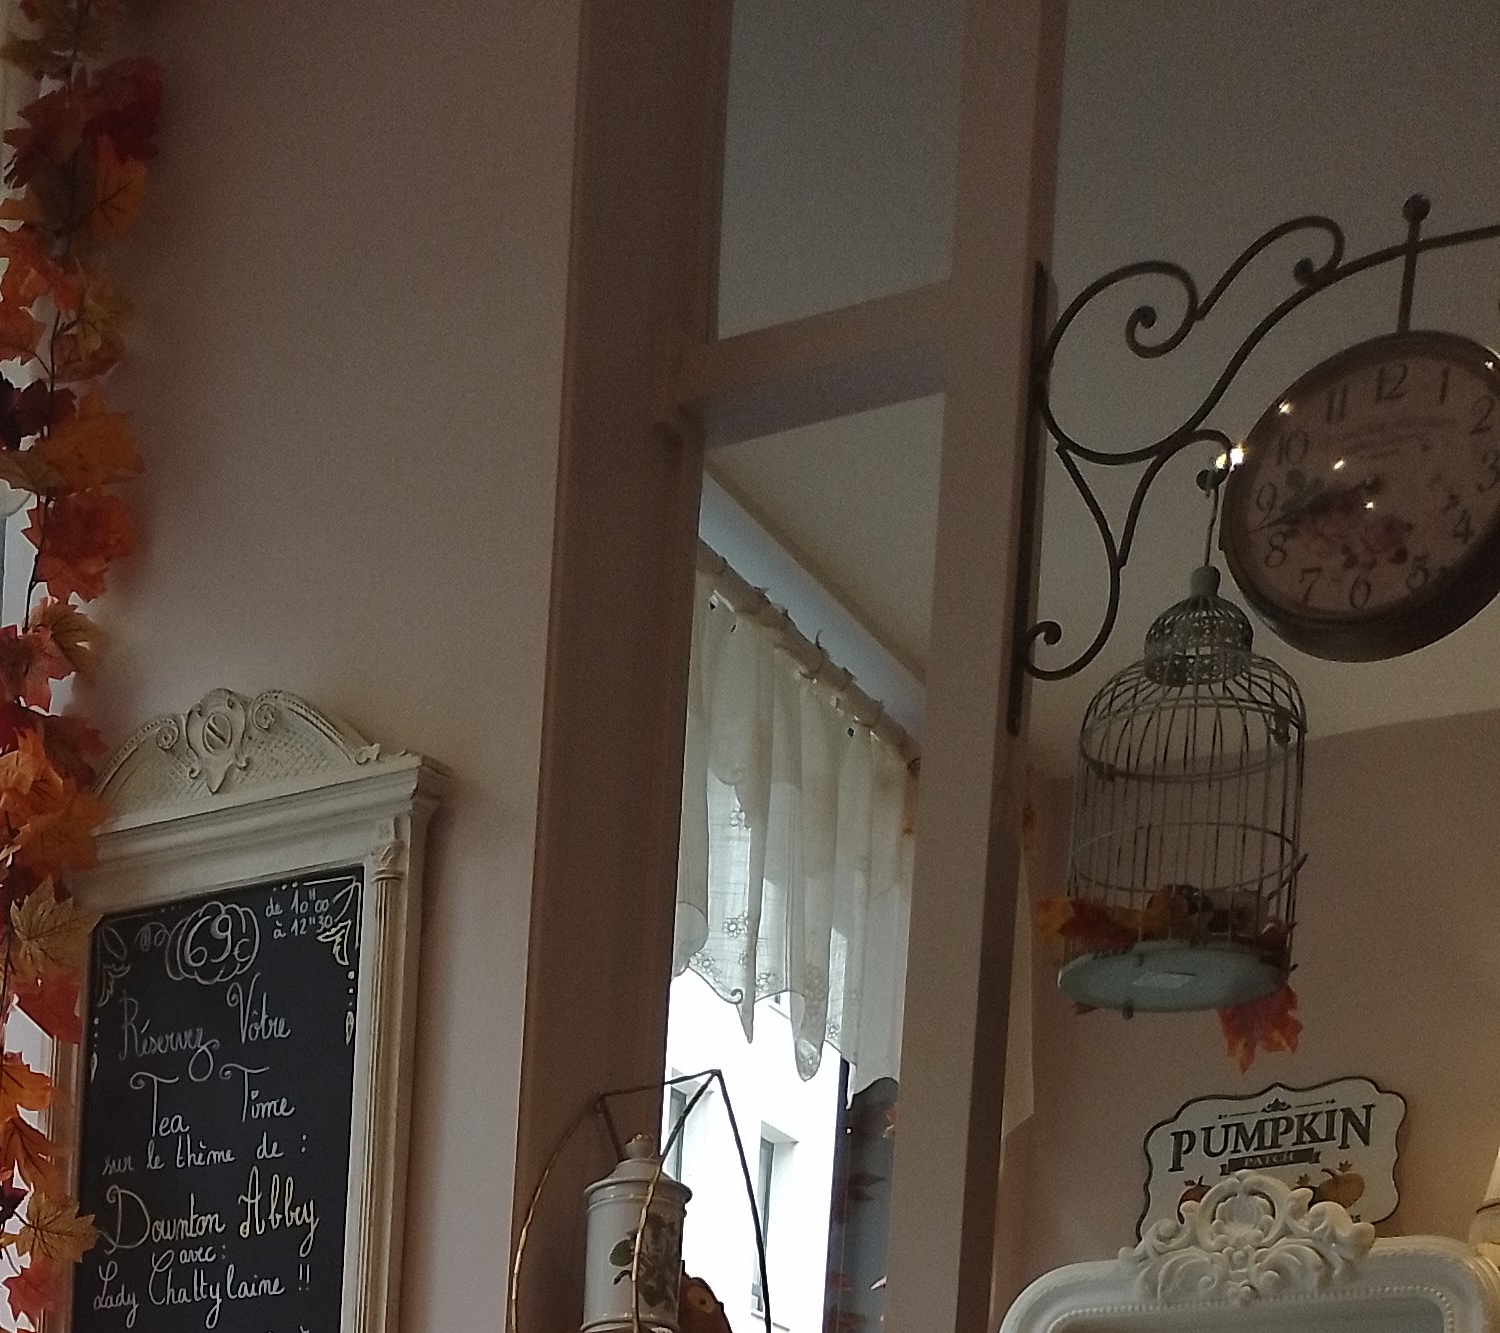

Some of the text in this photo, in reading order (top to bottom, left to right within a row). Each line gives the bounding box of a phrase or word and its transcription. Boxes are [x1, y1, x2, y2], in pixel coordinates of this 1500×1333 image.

[1376, 364, 1408, 403] 12
[1439, 369, 1449, 405] 1
[1326, 385, 1348, 422] 11
[1470, 396, 1496, 435] 2
[1276, 431, 1308, 467] 10
[1477, 452, 1500, 493] 3
[1253, 482, 1278, 532] 9
[1452, 509, 1476, 545] 4
[1264, 531, 1287, 568] 8
[1300, 567, 1322, 602] 7
[1405, 555, 1430, 591] 5
[266, 897, 283, 917] de
[273, 919, 286, 940] à
[119, 973, 291, 1081] Réservez Vôtre
[129, 1063, 296, 1137] Tea Time
[102, 1157, 134, 1175] sur
[146, 1139, 165, 1170] le
[176, 1133, 236, 1168] thème
[256, 1131, 284, 1160] de
[1168, 1103, 1376, 1173] PUMPKIN
[1243, 1149, 1296, 1168] PATCH
[97, 1184, 227, 1255] Downton
[93, 1260, 139, 1328] Lady
